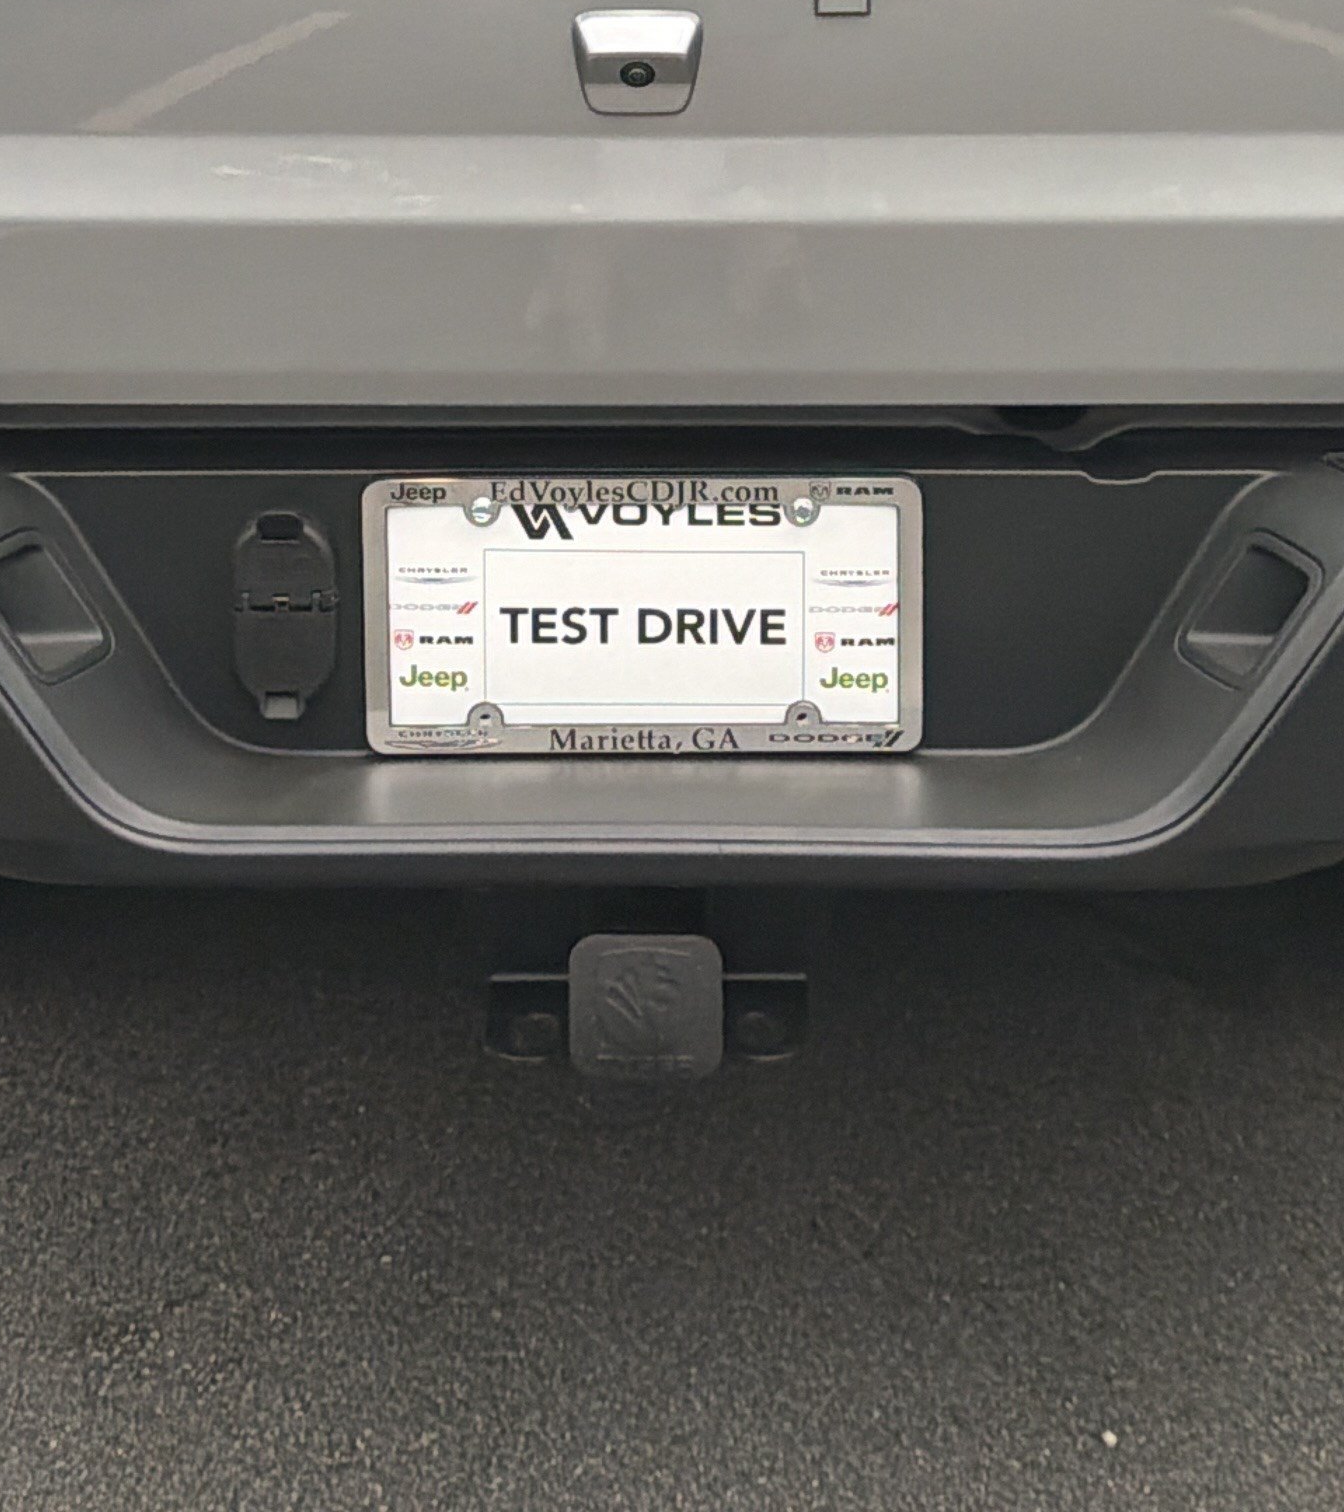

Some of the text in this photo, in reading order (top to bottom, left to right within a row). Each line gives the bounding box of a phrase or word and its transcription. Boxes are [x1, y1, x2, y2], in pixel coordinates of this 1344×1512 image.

[390, 482, 447, 504] Jeep
[490, 480, 780, 509] EdVoylesCDJR.com
[835, 486, 895, 496] RAM
[577, 503, 782, 526] VOYLES
[398, 566, 469, 574] CHRYSLER
[820, 569, 891, 577] CHRYSLER
[500, 607, 787, 646] TEST DRIVE
[419, 634, 474, 645] RAM
[840, 636, 896, 647] RAM
[399, 664, 468, 692] Jeep
[819, 666, 889, 693] Jeep
[549, 726, 740, 752] Marietta, GA
